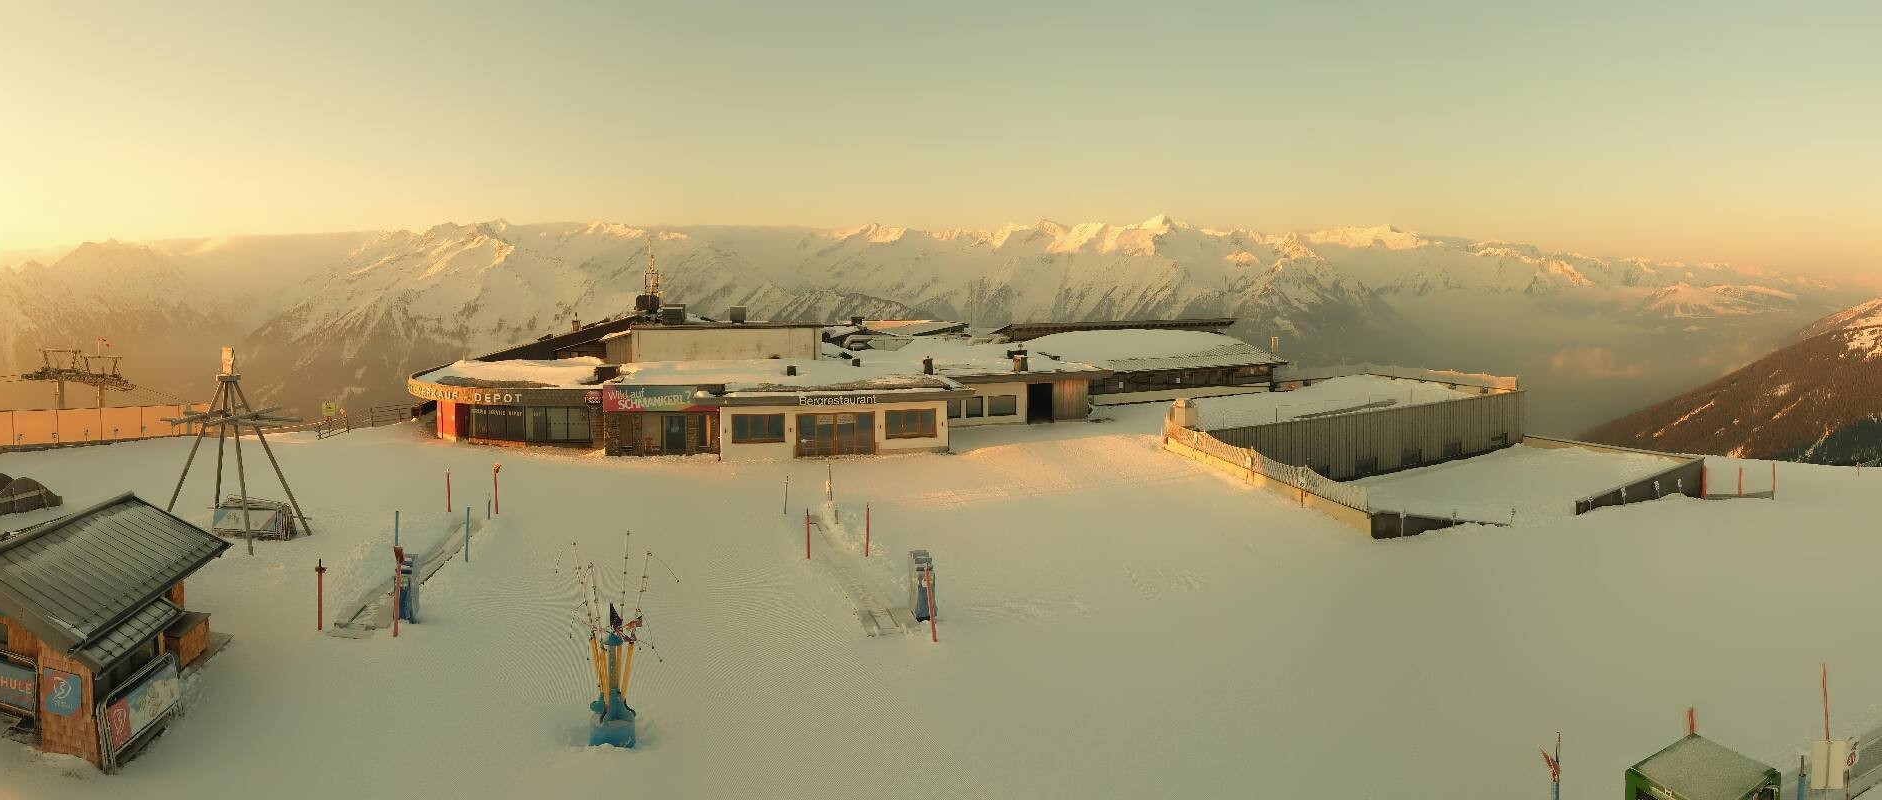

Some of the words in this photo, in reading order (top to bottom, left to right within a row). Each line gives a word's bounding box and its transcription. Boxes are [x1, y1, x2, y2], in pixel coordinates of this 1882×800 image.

[475, 393, 522, 402] DEPOT
[630, 388, 645, 398] auf
[799, 395, 877, 407] Bergrestaurant
